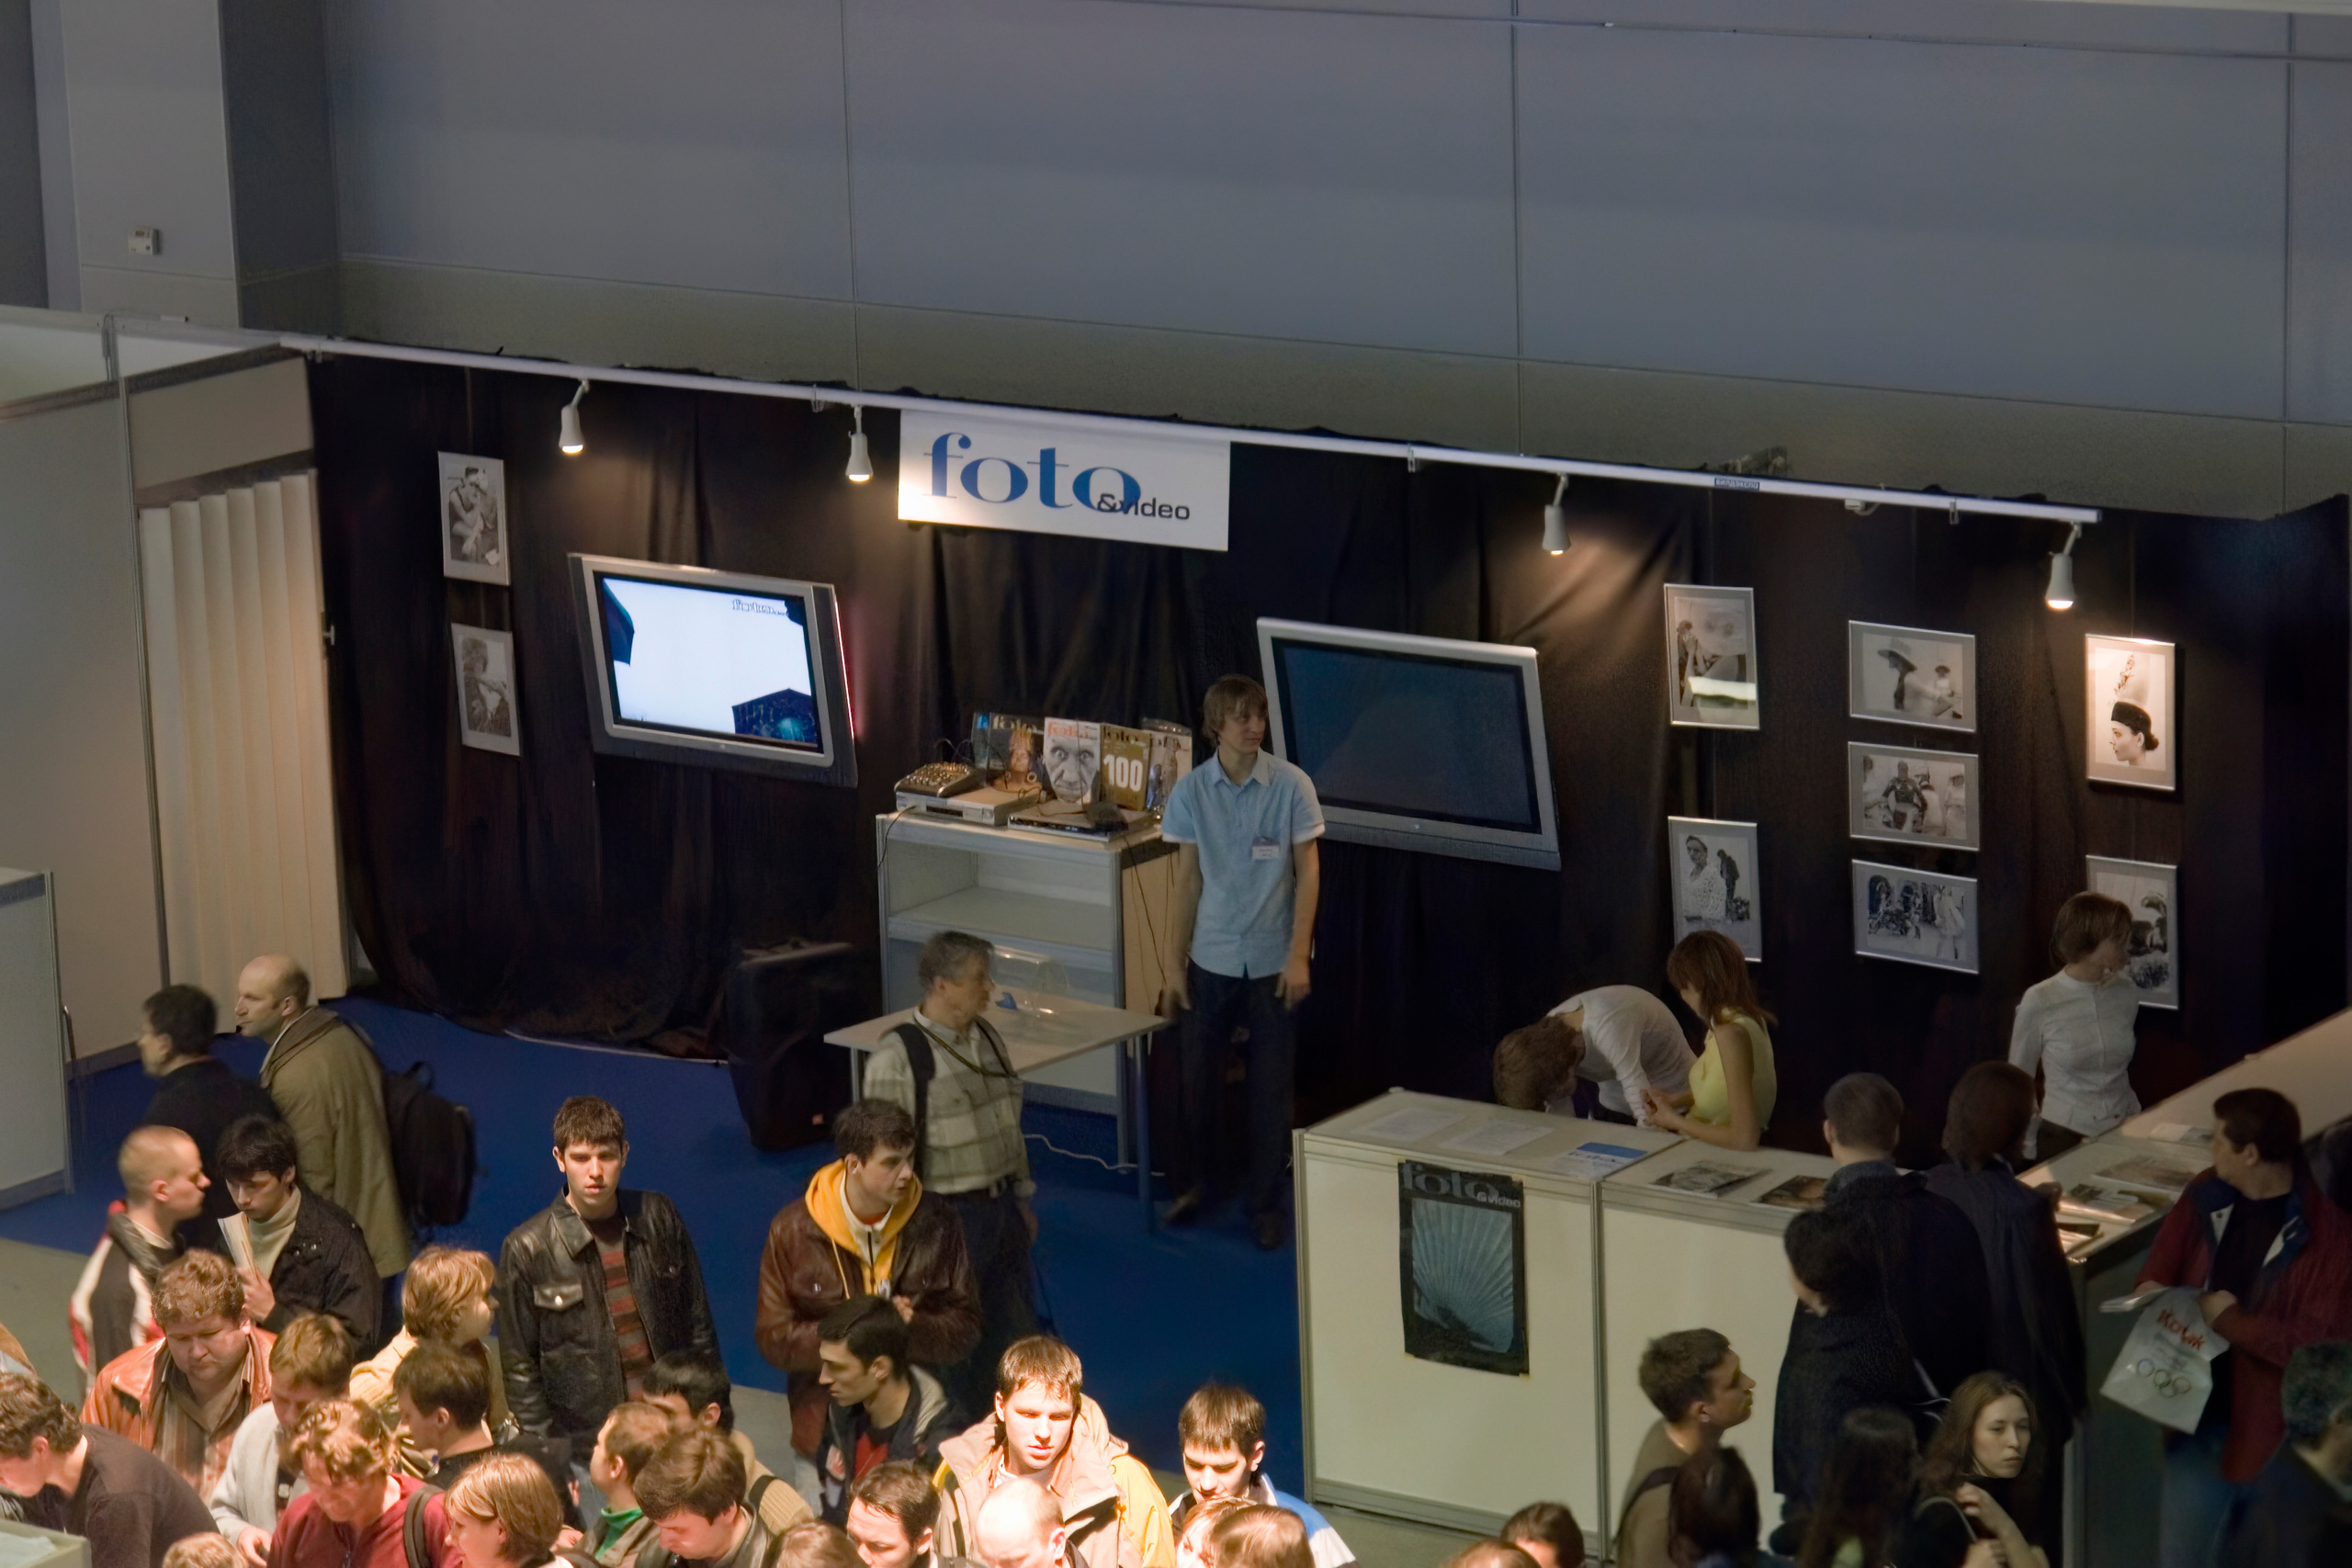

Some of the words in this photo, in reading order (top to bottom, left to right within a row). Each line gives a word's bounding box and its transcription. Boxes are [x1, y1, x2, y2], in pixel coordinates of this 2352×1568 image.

[922, 432, 1141, 513] foto
[1097, 493, 1191, 521] &video
[1102, 753, 1144, 793] 100
[1476, 1190, 1521, 1208] &video
